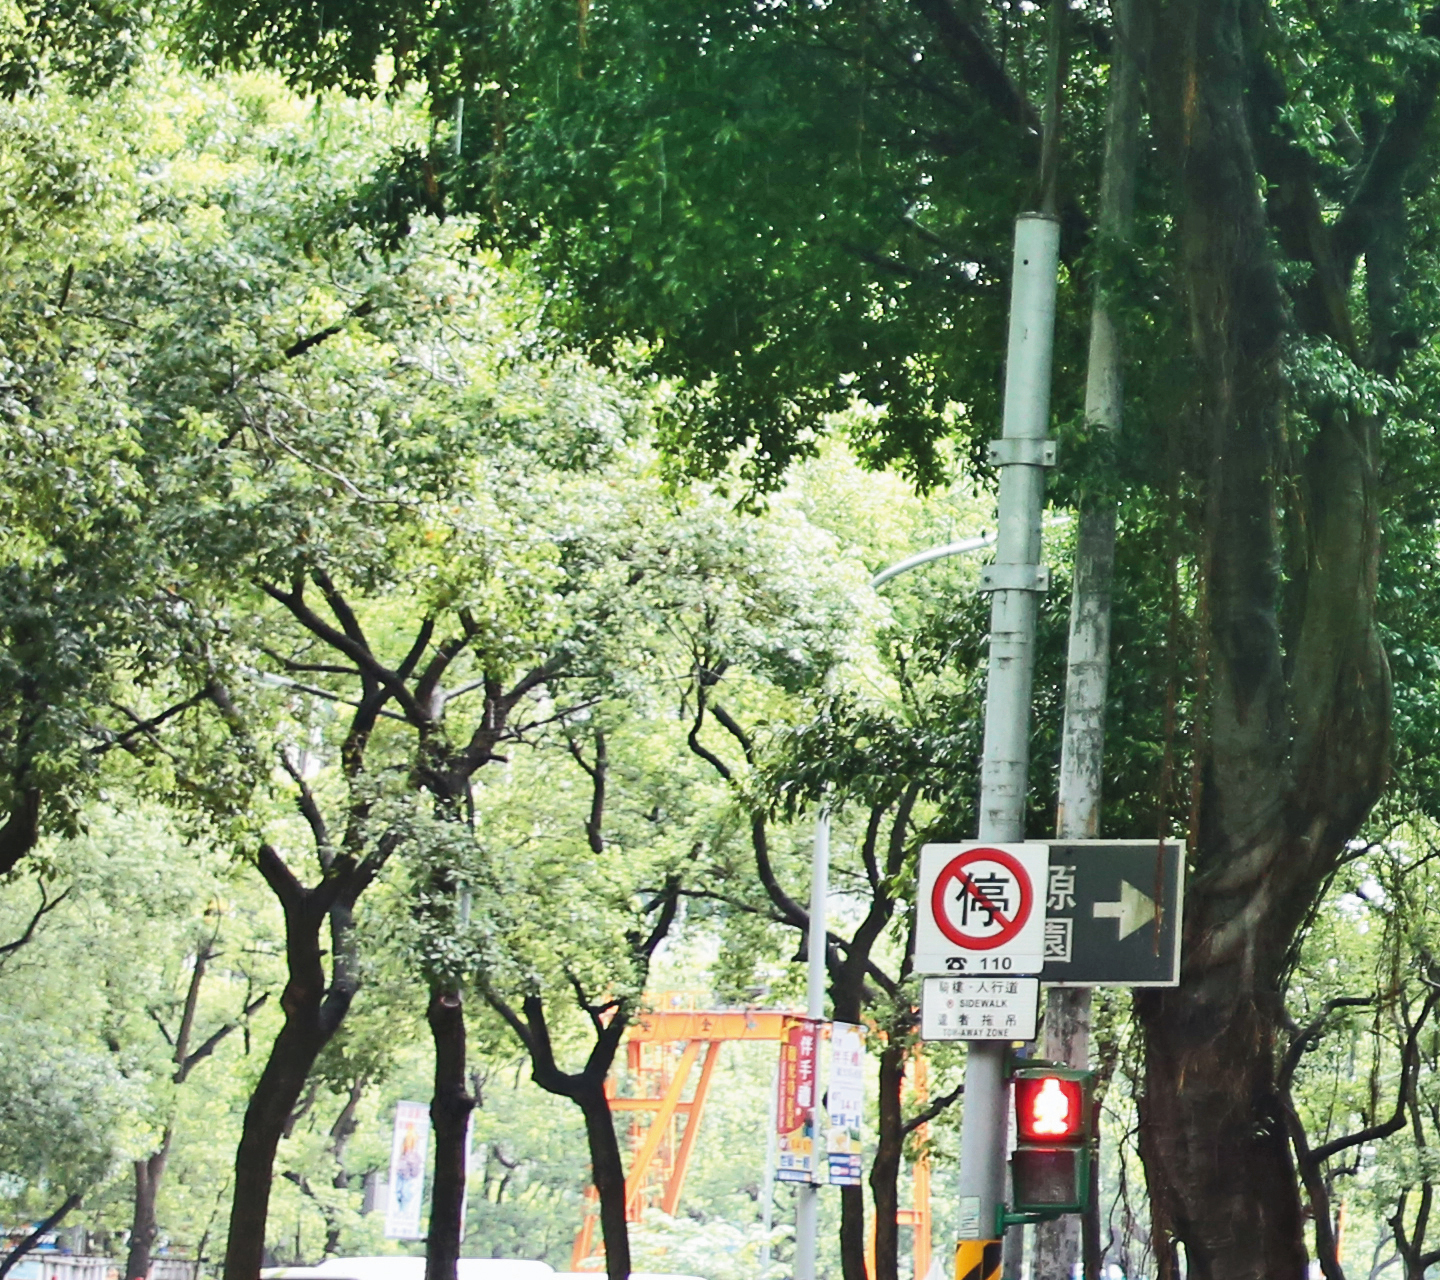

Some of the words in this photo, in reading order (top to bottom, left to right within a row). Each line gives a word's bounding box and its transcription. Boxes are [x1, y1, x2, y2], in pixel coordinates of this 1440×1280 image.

[955, 872, 1010, 927] 停
[980, 957, 1012, 970] 110
[959, 999, 1008, 1008] SIDEWALK
[986, 1028, 1009, 1037] ZONE
